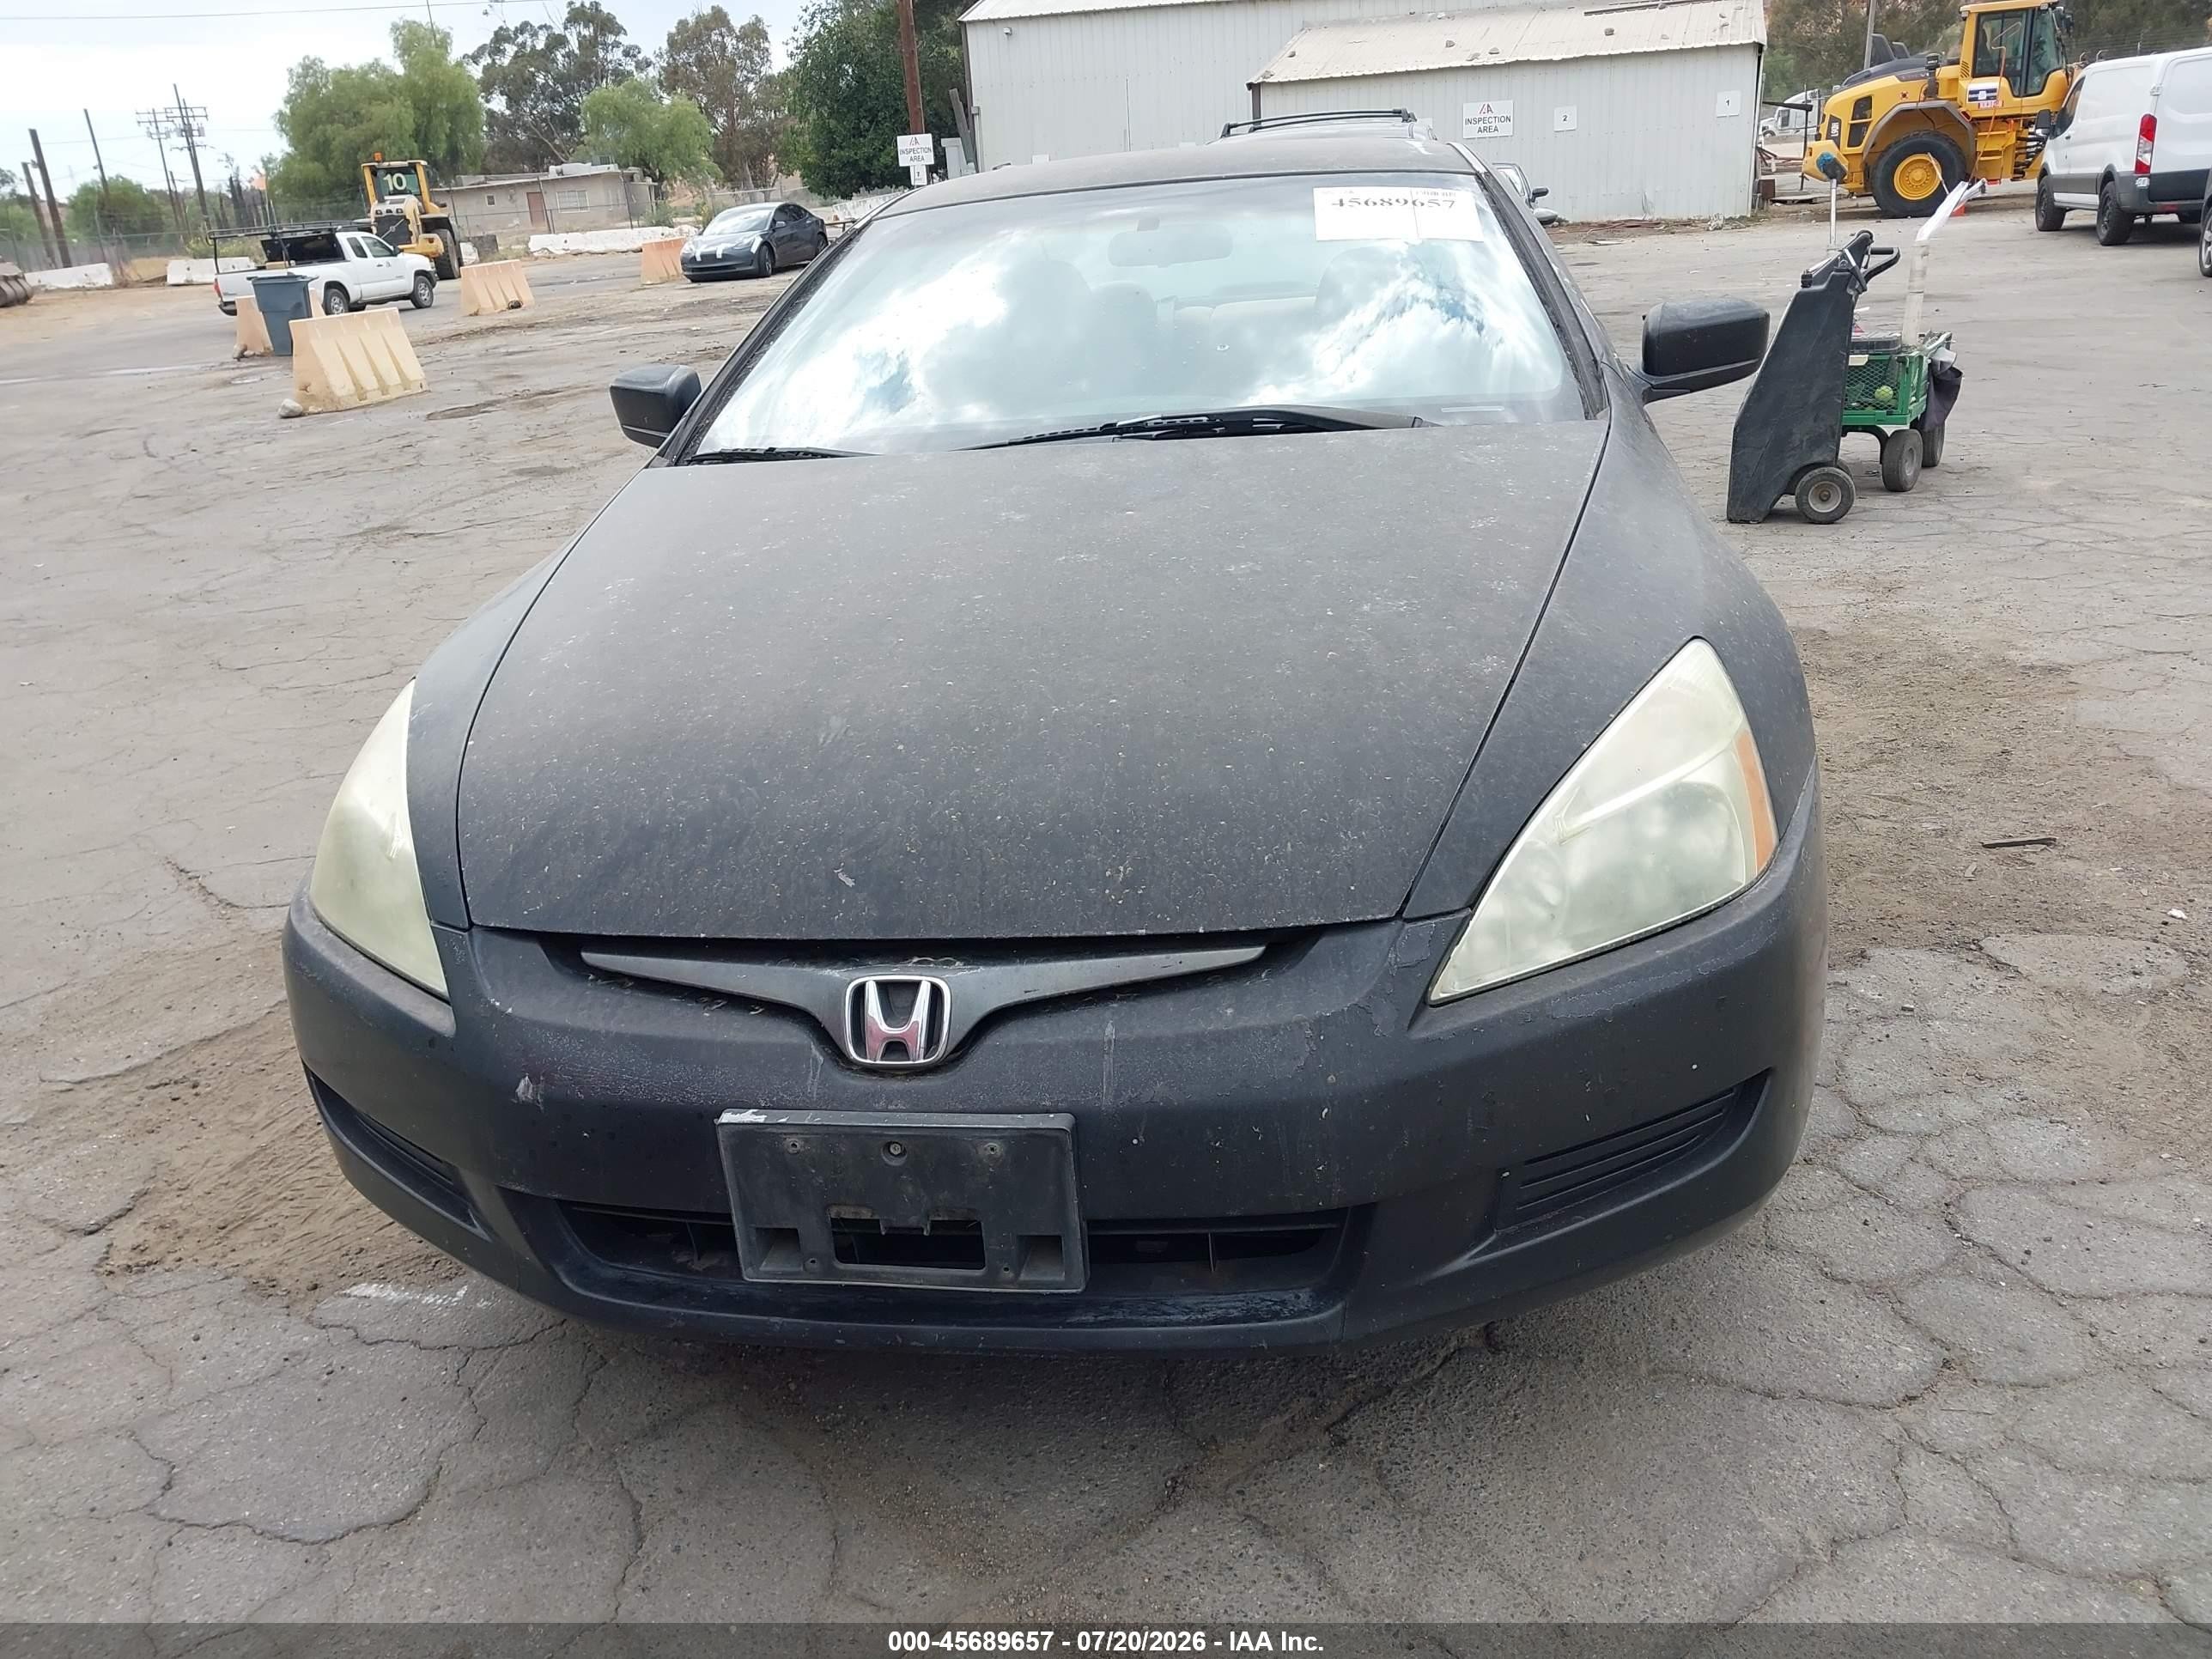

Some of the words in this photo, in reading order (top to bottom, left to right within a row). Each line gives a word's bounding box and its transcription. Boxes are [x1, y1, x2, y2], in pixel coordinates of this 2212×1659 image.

[1464, 115, 1511, 125] INSPECTION
[1477, 125, 1499, 134] AREA
[899, 146, 933, 155] INSPECTION
[383, 173, 407, 191] 10
[1332, 198, 1455, 209] 45689657
